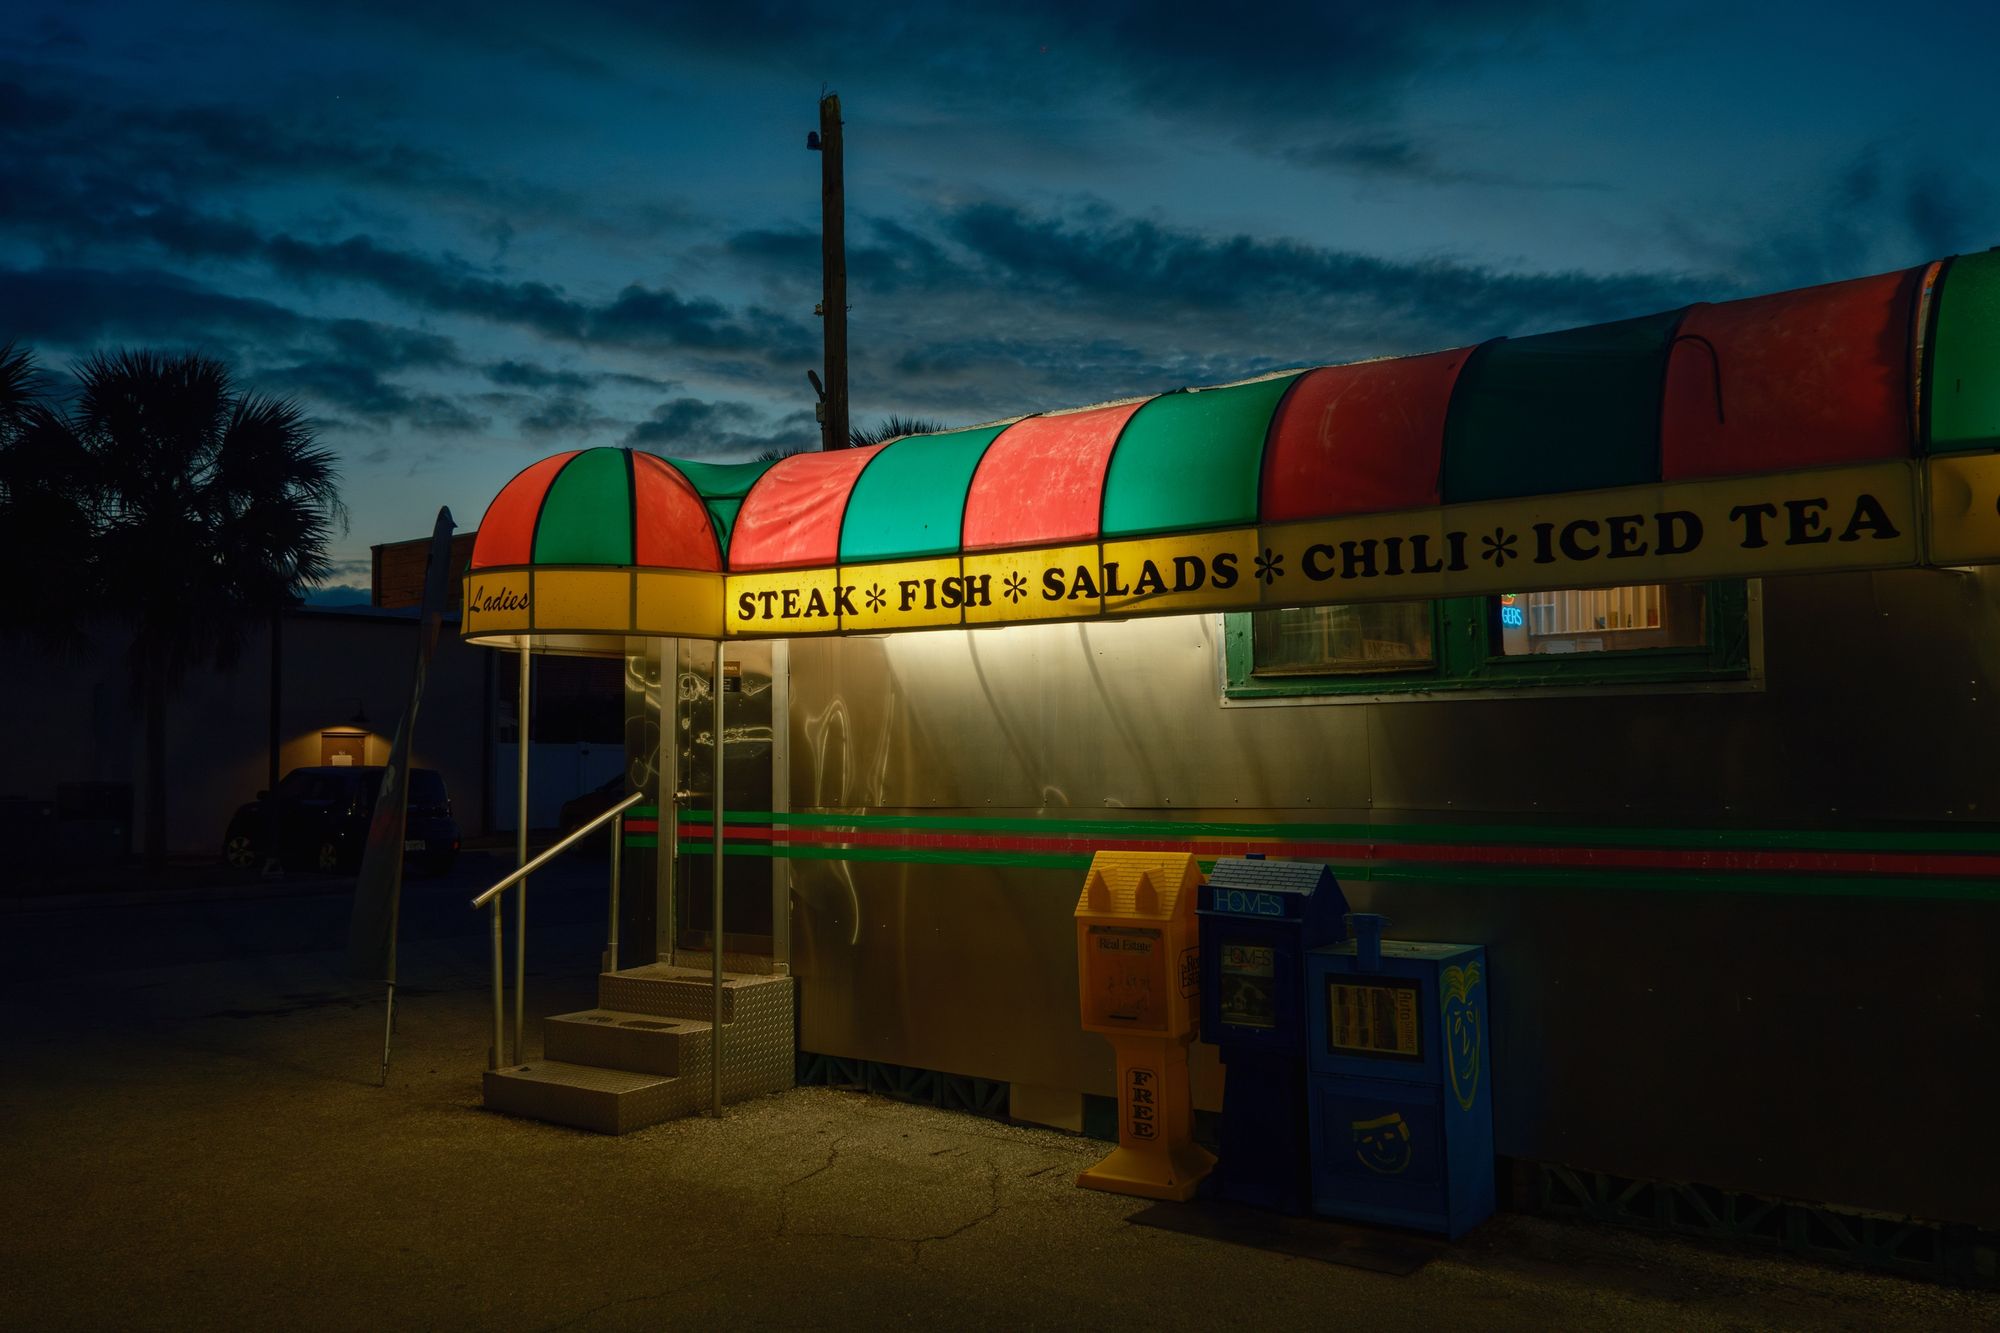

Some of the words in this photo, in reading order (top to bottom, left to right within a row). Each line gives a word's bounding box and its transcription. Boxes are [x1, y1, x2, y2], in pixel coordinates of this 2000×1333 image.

[738, 585, 859, 621] STEAK
[898, 574, 992, 612] FISH
[1042, 553, 1239, 601] SALADS
[1301, 531, 1469, 582] CHILI
[1533, 510, 1704, 564] ICED
[1730, 494, 1901, 549] TEA
[469, 585, 531, 613] Ladies
[1215, 887, 1282, 916] HOMES
[1099, 937, 1120, 951] Real
[1122, 938, 1153, 953] Estate
[1222, 946, 1274, 967] HOMES
[1131, 1070, 1155, 1138] FREE
